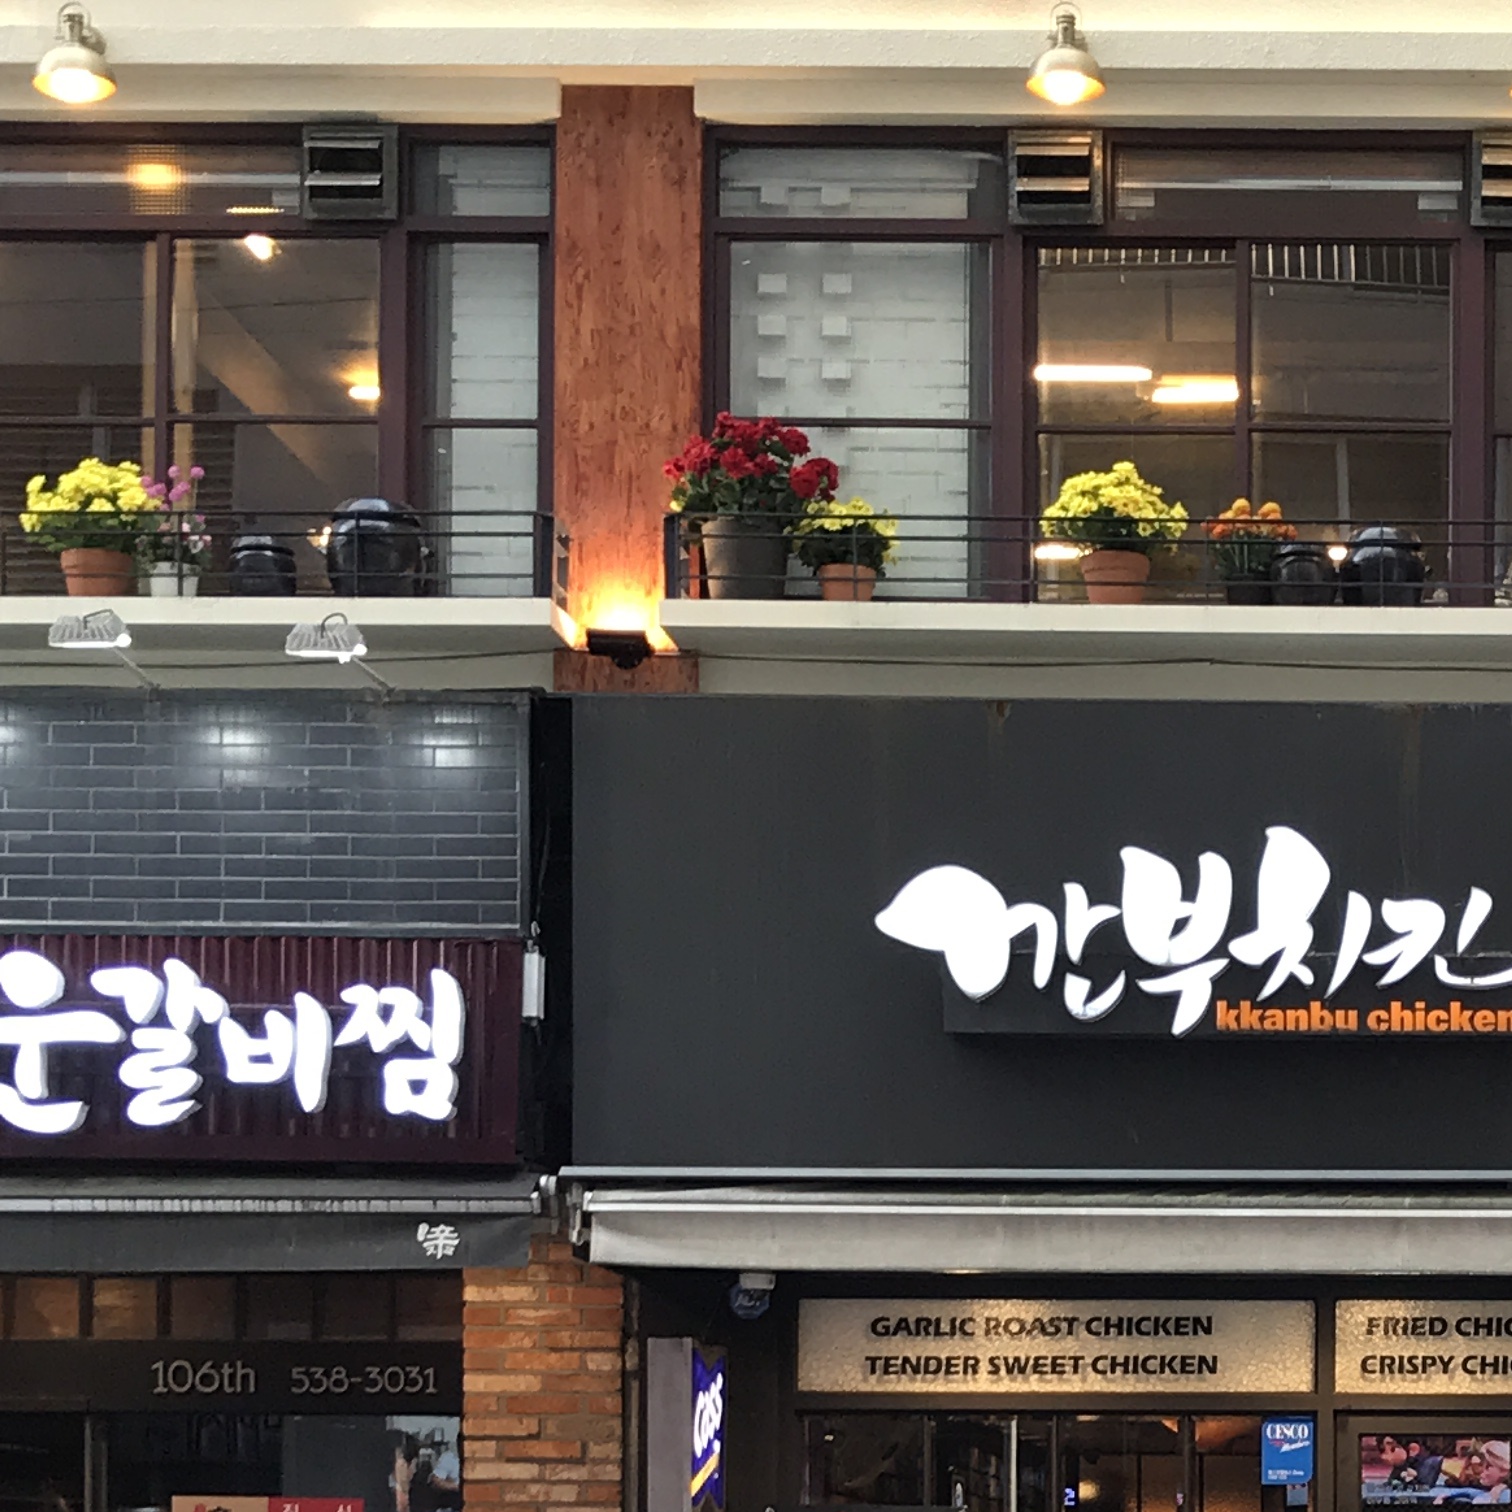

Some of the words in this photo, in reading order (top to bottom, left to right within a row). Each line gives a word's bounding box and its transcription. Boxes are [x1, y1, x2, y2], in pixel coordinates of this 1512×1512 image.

[1216, 1000, 1358, 1032] kkanbu
[870, 1315, 976, 1336] GARLIC
[985, 1315, 1079, 1336] ROAST
[1085, 1315, 1213, 1336] CHICKEN
[1366, 1316, 1447, 1337] FRIED
[865, 1355, 980, 1376] TENDER
[987, 1355, 1085, 1376] SWEET
[1091, 1354, 1218, 1375] CHICKEN
[1360, 1355, 1456, 1376] CRISPY
[151, 1360, 257, 1395] 106th
[291, 1366, 438, 1395] 538-3031
[1266, 1424, 1309, 1439] CESCO
